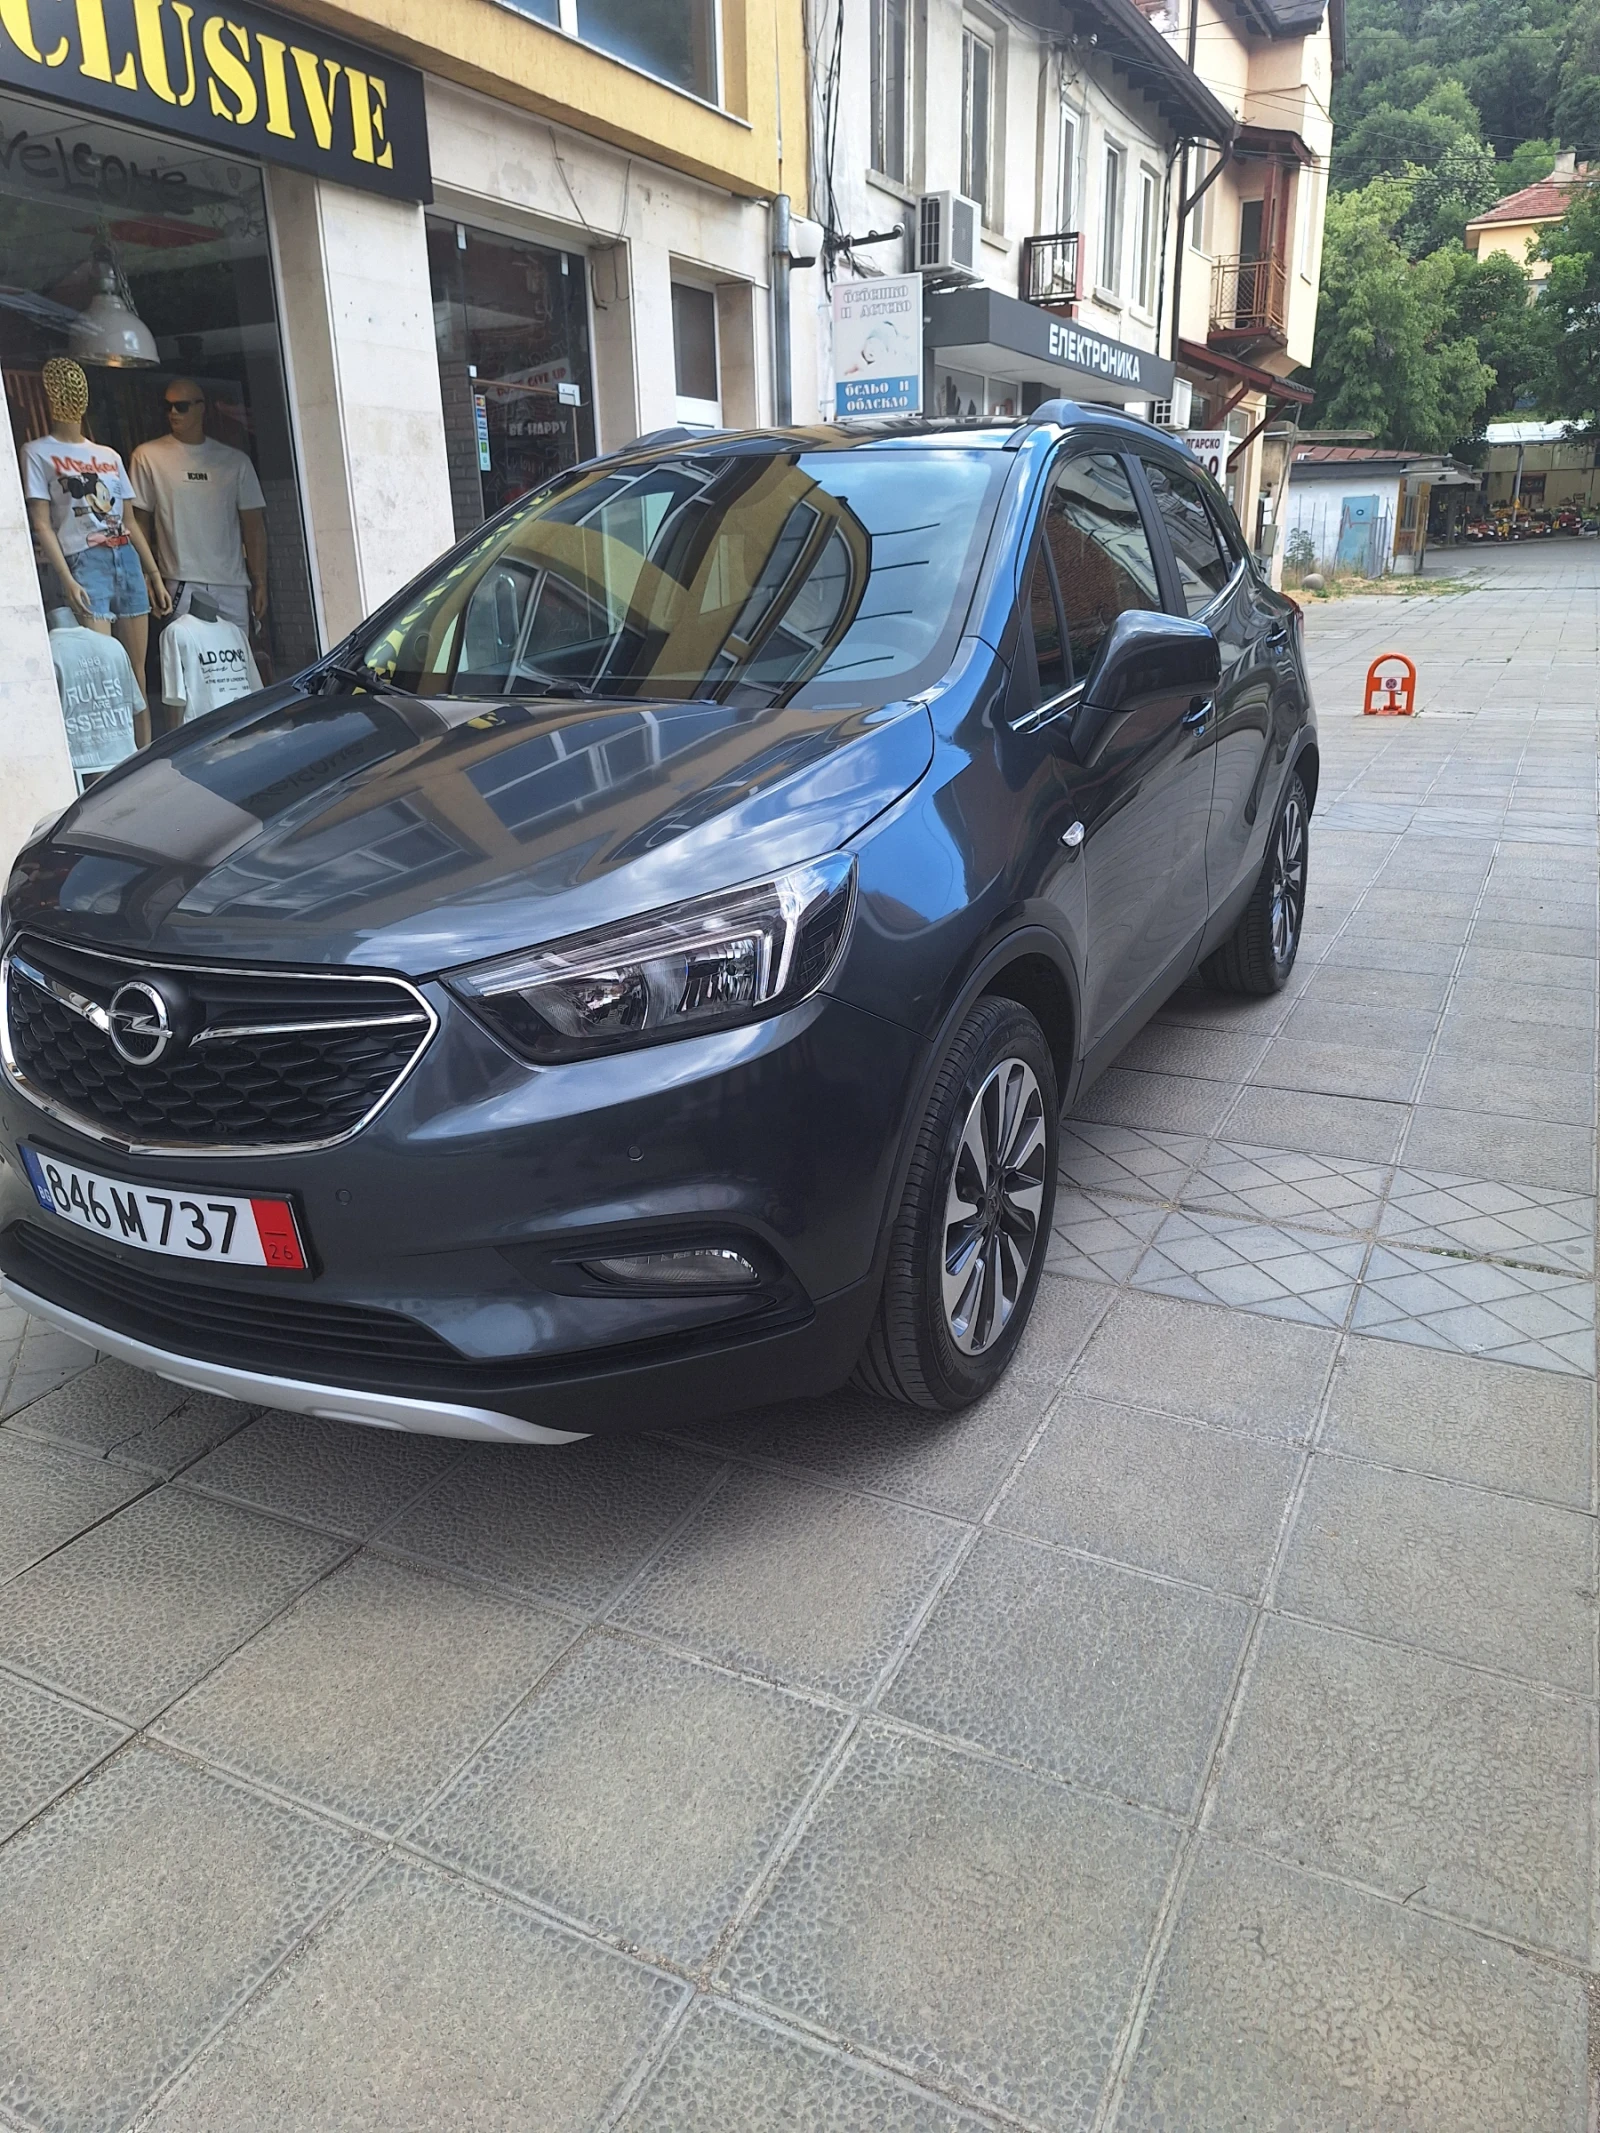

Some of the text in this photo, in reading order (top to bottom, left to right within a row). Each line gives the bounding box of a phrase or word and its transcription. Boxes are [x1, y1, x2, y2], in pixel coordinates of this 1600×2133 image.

[1049, 323, 1140, 383] ЕЛЕКТРОНИКА
[527, 420, 568, 436] HAPPY
[198, 650, 218, 666] LD
[66, 677, 123, 707] RULES
[268, 1243, 295, 1261] 26
